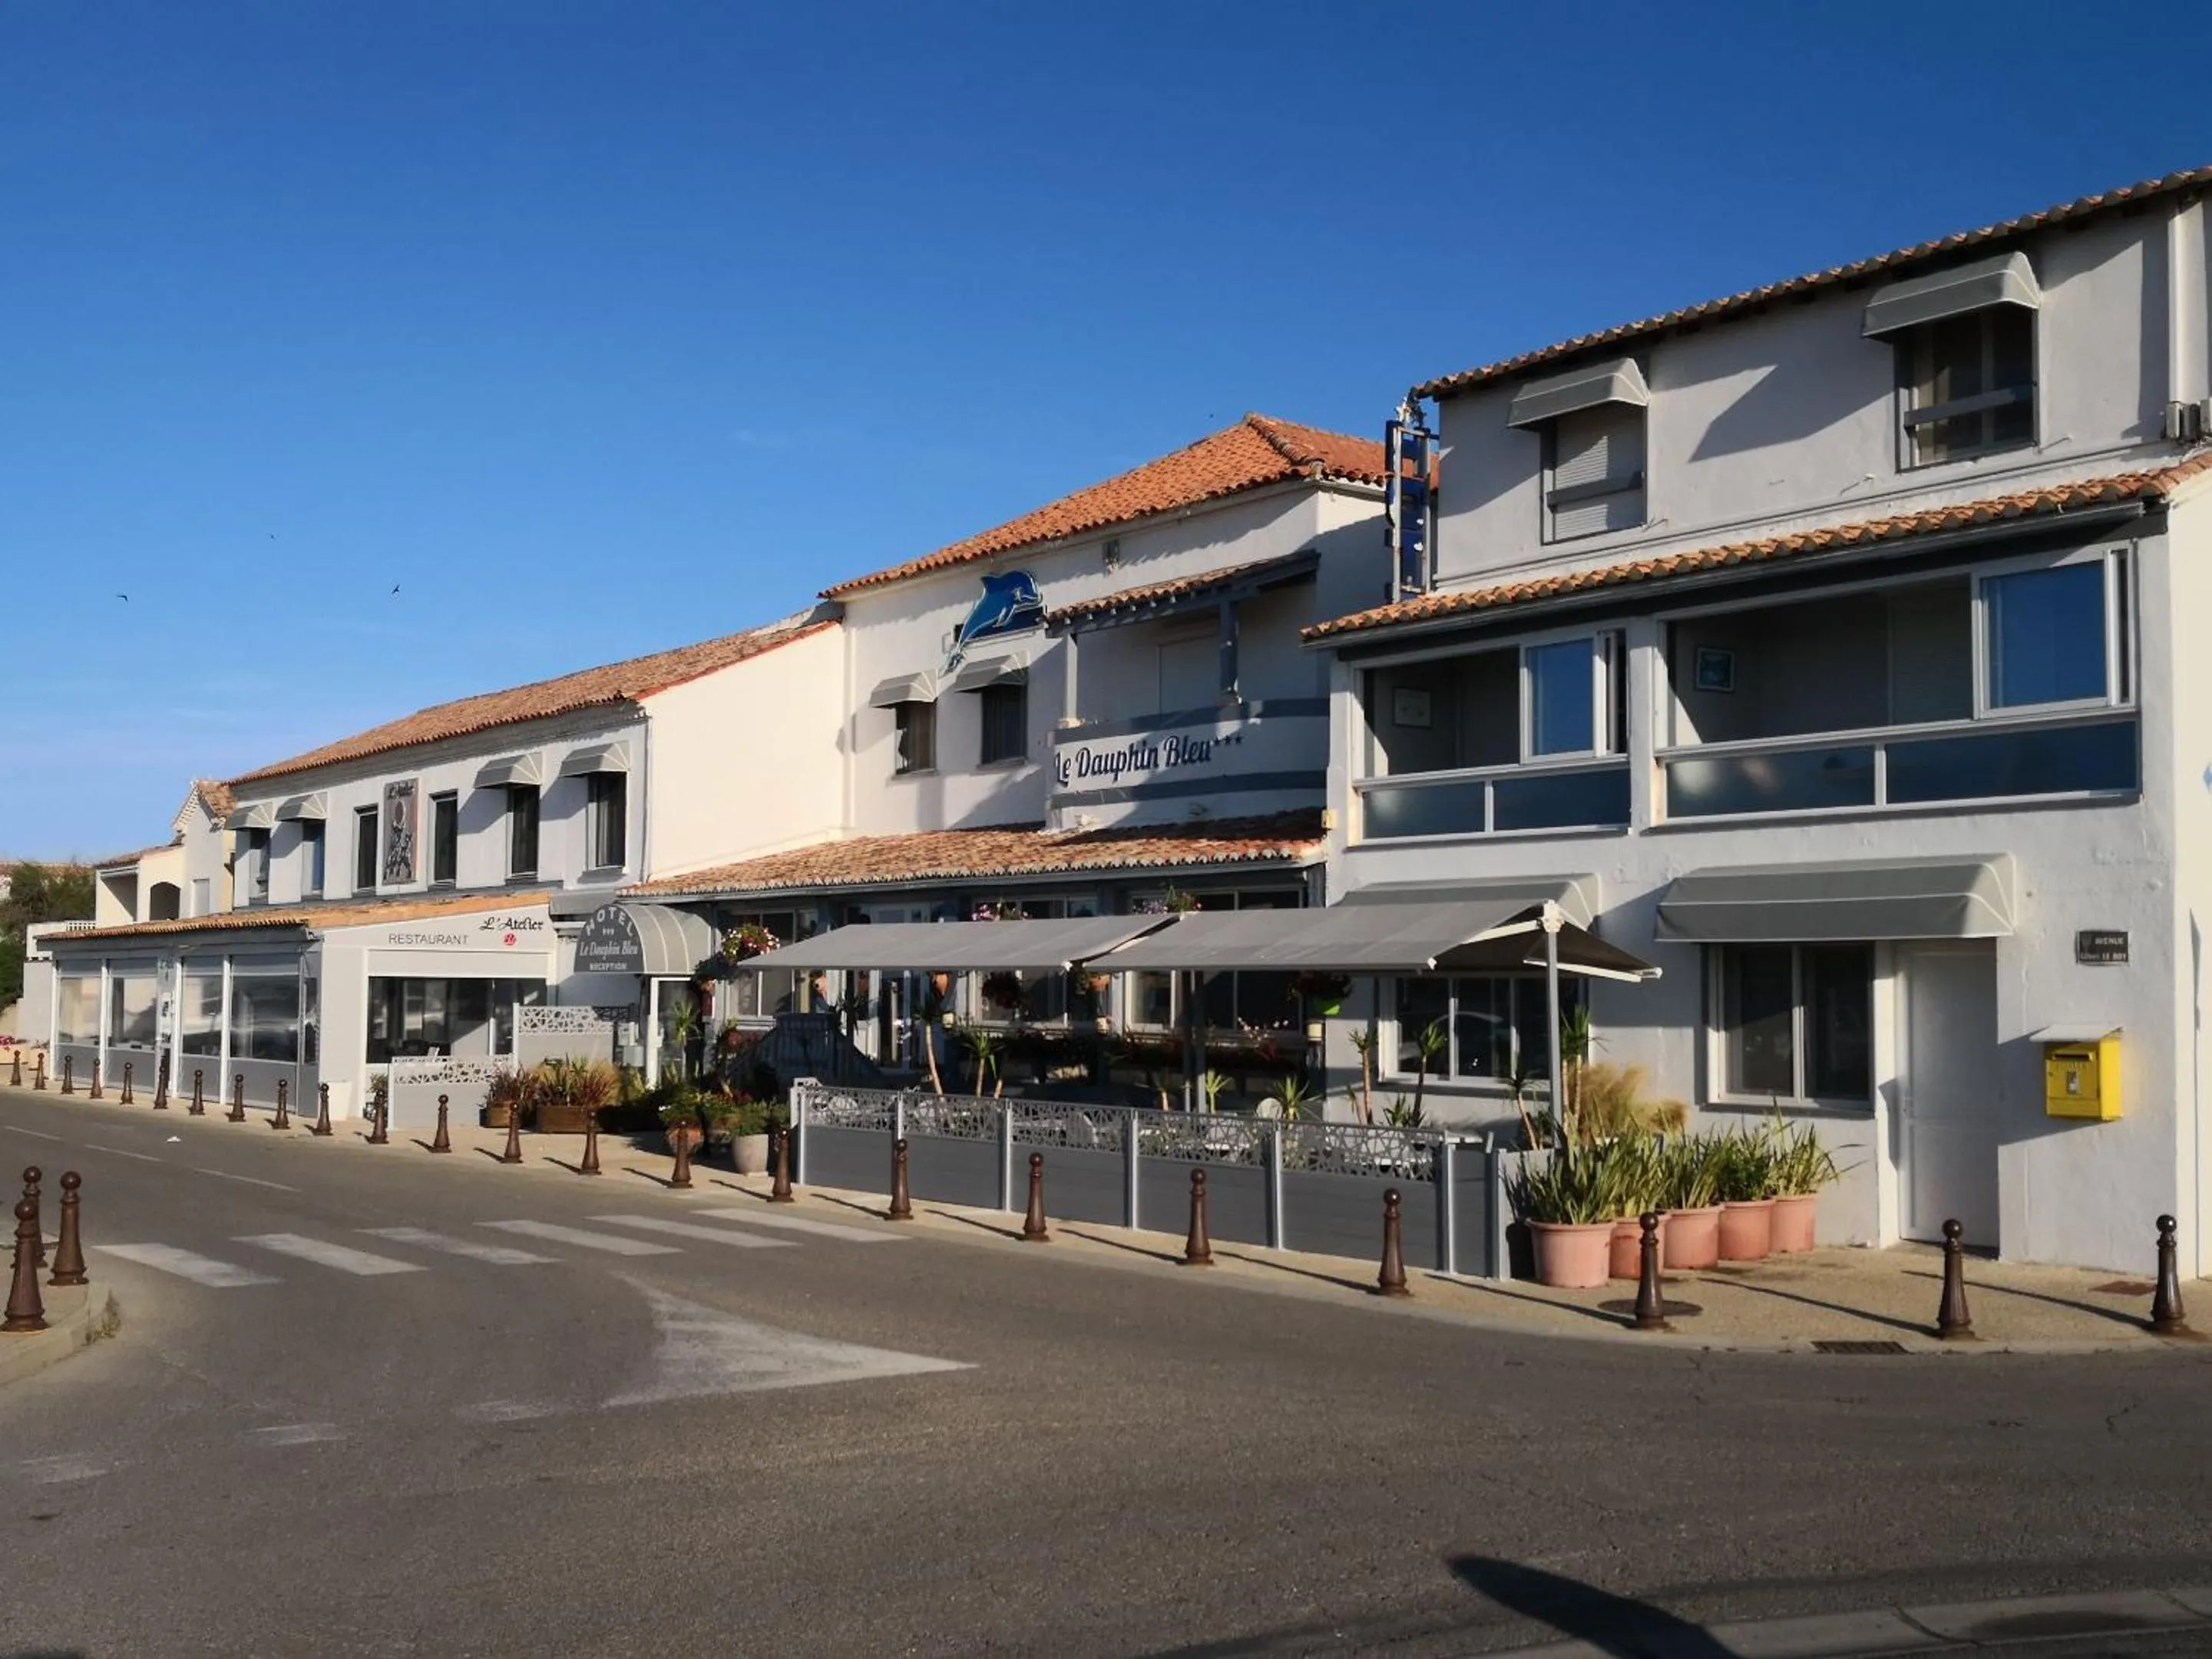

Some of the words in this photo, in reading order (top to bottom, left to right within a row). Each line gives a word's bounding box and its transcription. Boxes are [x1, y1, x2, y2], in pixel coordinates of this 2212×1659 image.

[1055, 752, 1073, 787] Le
[1076, 741, 1159, 783] Dauphin
[1163, 735, 1212, 768] Bleu
[479, 917, 544, 930] L'Atelier
[586, 907, 633, 937] HOTEL
[388, 933, 468, 945] RESTAURANT
[589, 962, 627, 971] RECEPTION
